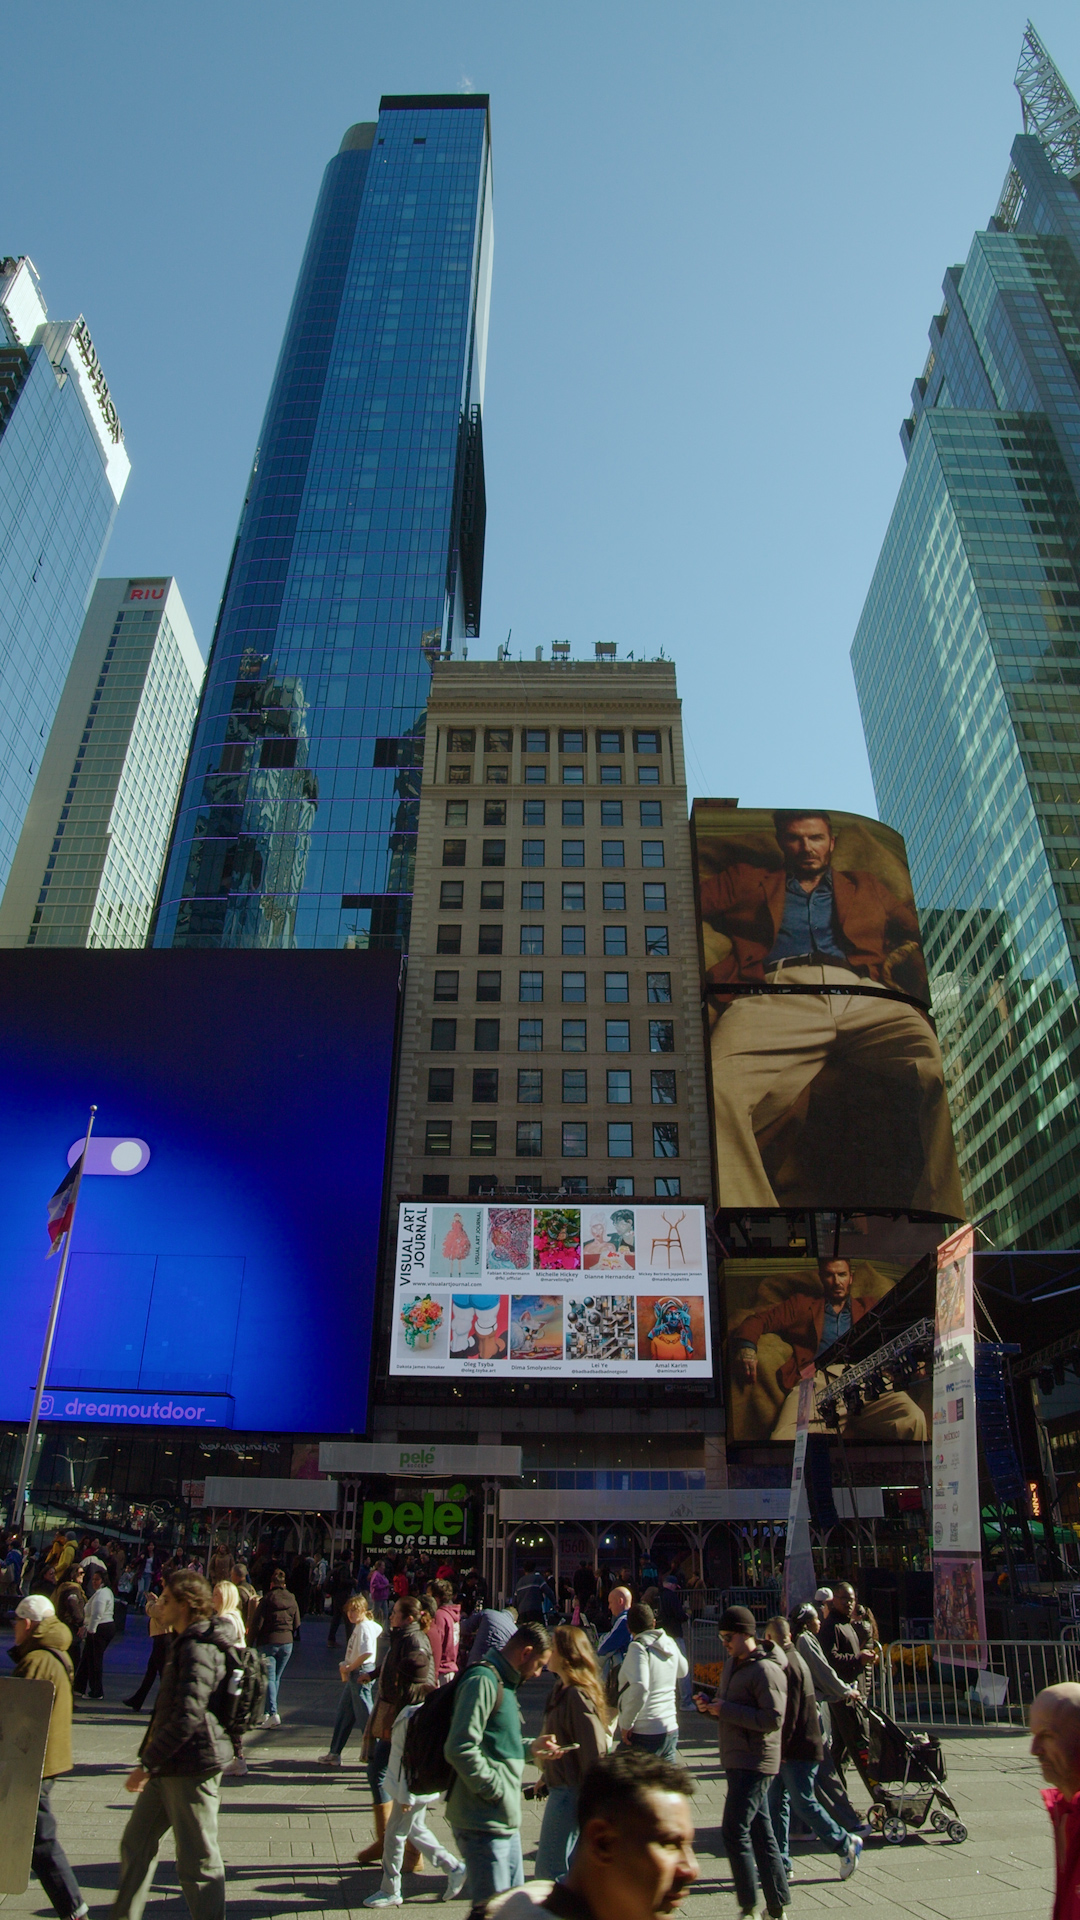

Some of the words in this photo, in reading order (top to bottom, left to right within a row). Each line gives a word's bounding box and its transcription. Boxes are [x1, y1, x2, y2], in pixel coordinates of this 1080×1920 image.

[130, 588, 164, 600] RIU
[404, 1207, 415, 1233] ART
[414, 1207, 428, 1268] JOURNAL
[400, 1238, 413, 1286] VISUAL
[53, 1398, 216, 1422] _dreamoutdoor_
[399, 1446, 436, 1467] pelé
[361, 1483, 467, 1544] pelé
[384, 1535, 448, 1545] SOCCER
